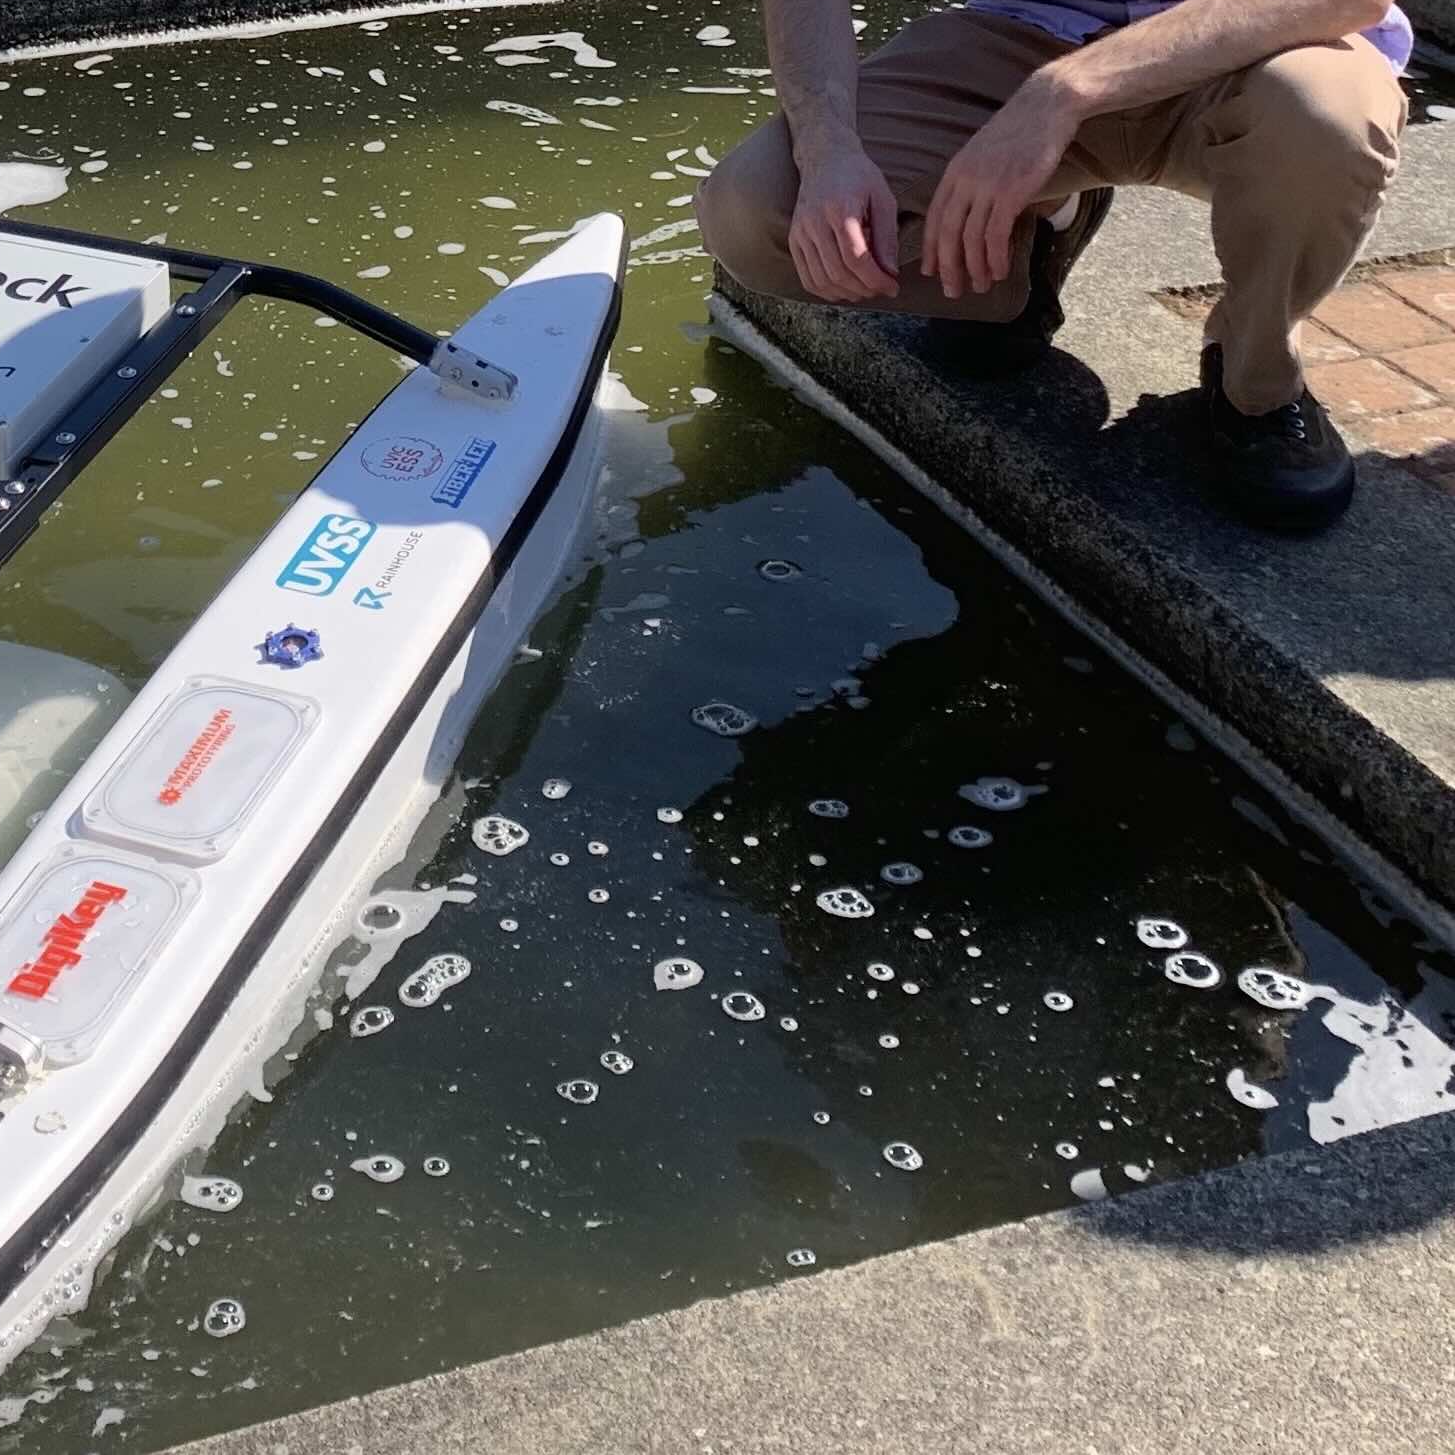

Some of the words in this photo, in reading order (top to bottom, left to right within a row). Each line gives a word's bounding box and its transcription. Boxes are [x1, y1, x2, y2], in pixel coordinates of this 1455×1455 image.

[395, 449, 424, 472] ESS
[283, 516, 371, 594] UVSS
[375, 530, 424, 589] RAINHOUSE
